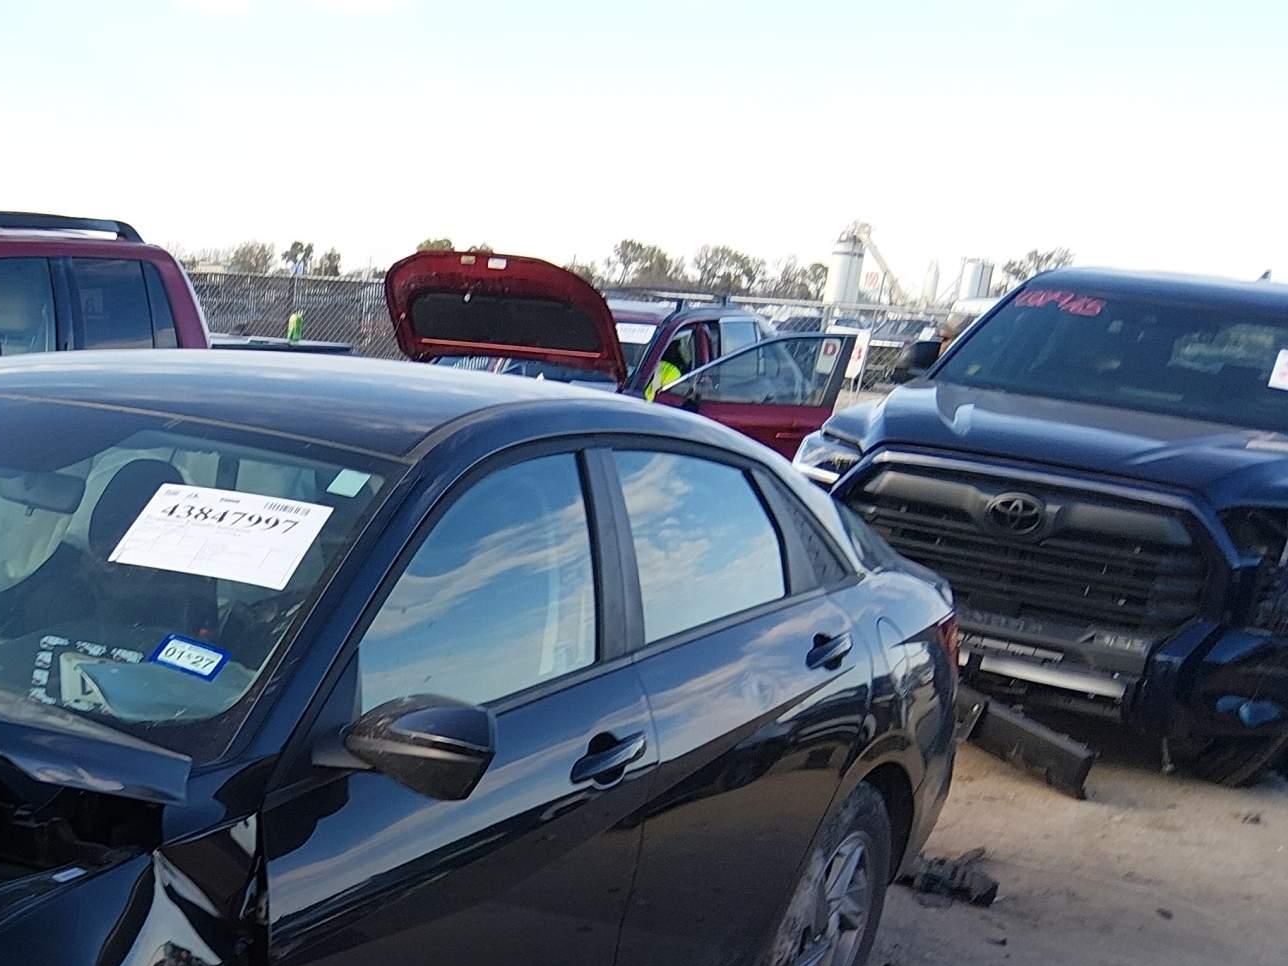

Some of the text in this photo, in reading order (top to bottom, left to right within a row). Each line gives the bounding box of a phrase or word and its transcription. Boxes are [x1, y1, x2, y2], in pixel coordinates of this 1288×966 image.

[161, 503, 300, 535] 43847997
[164, 646, 216, 670] 01 27
